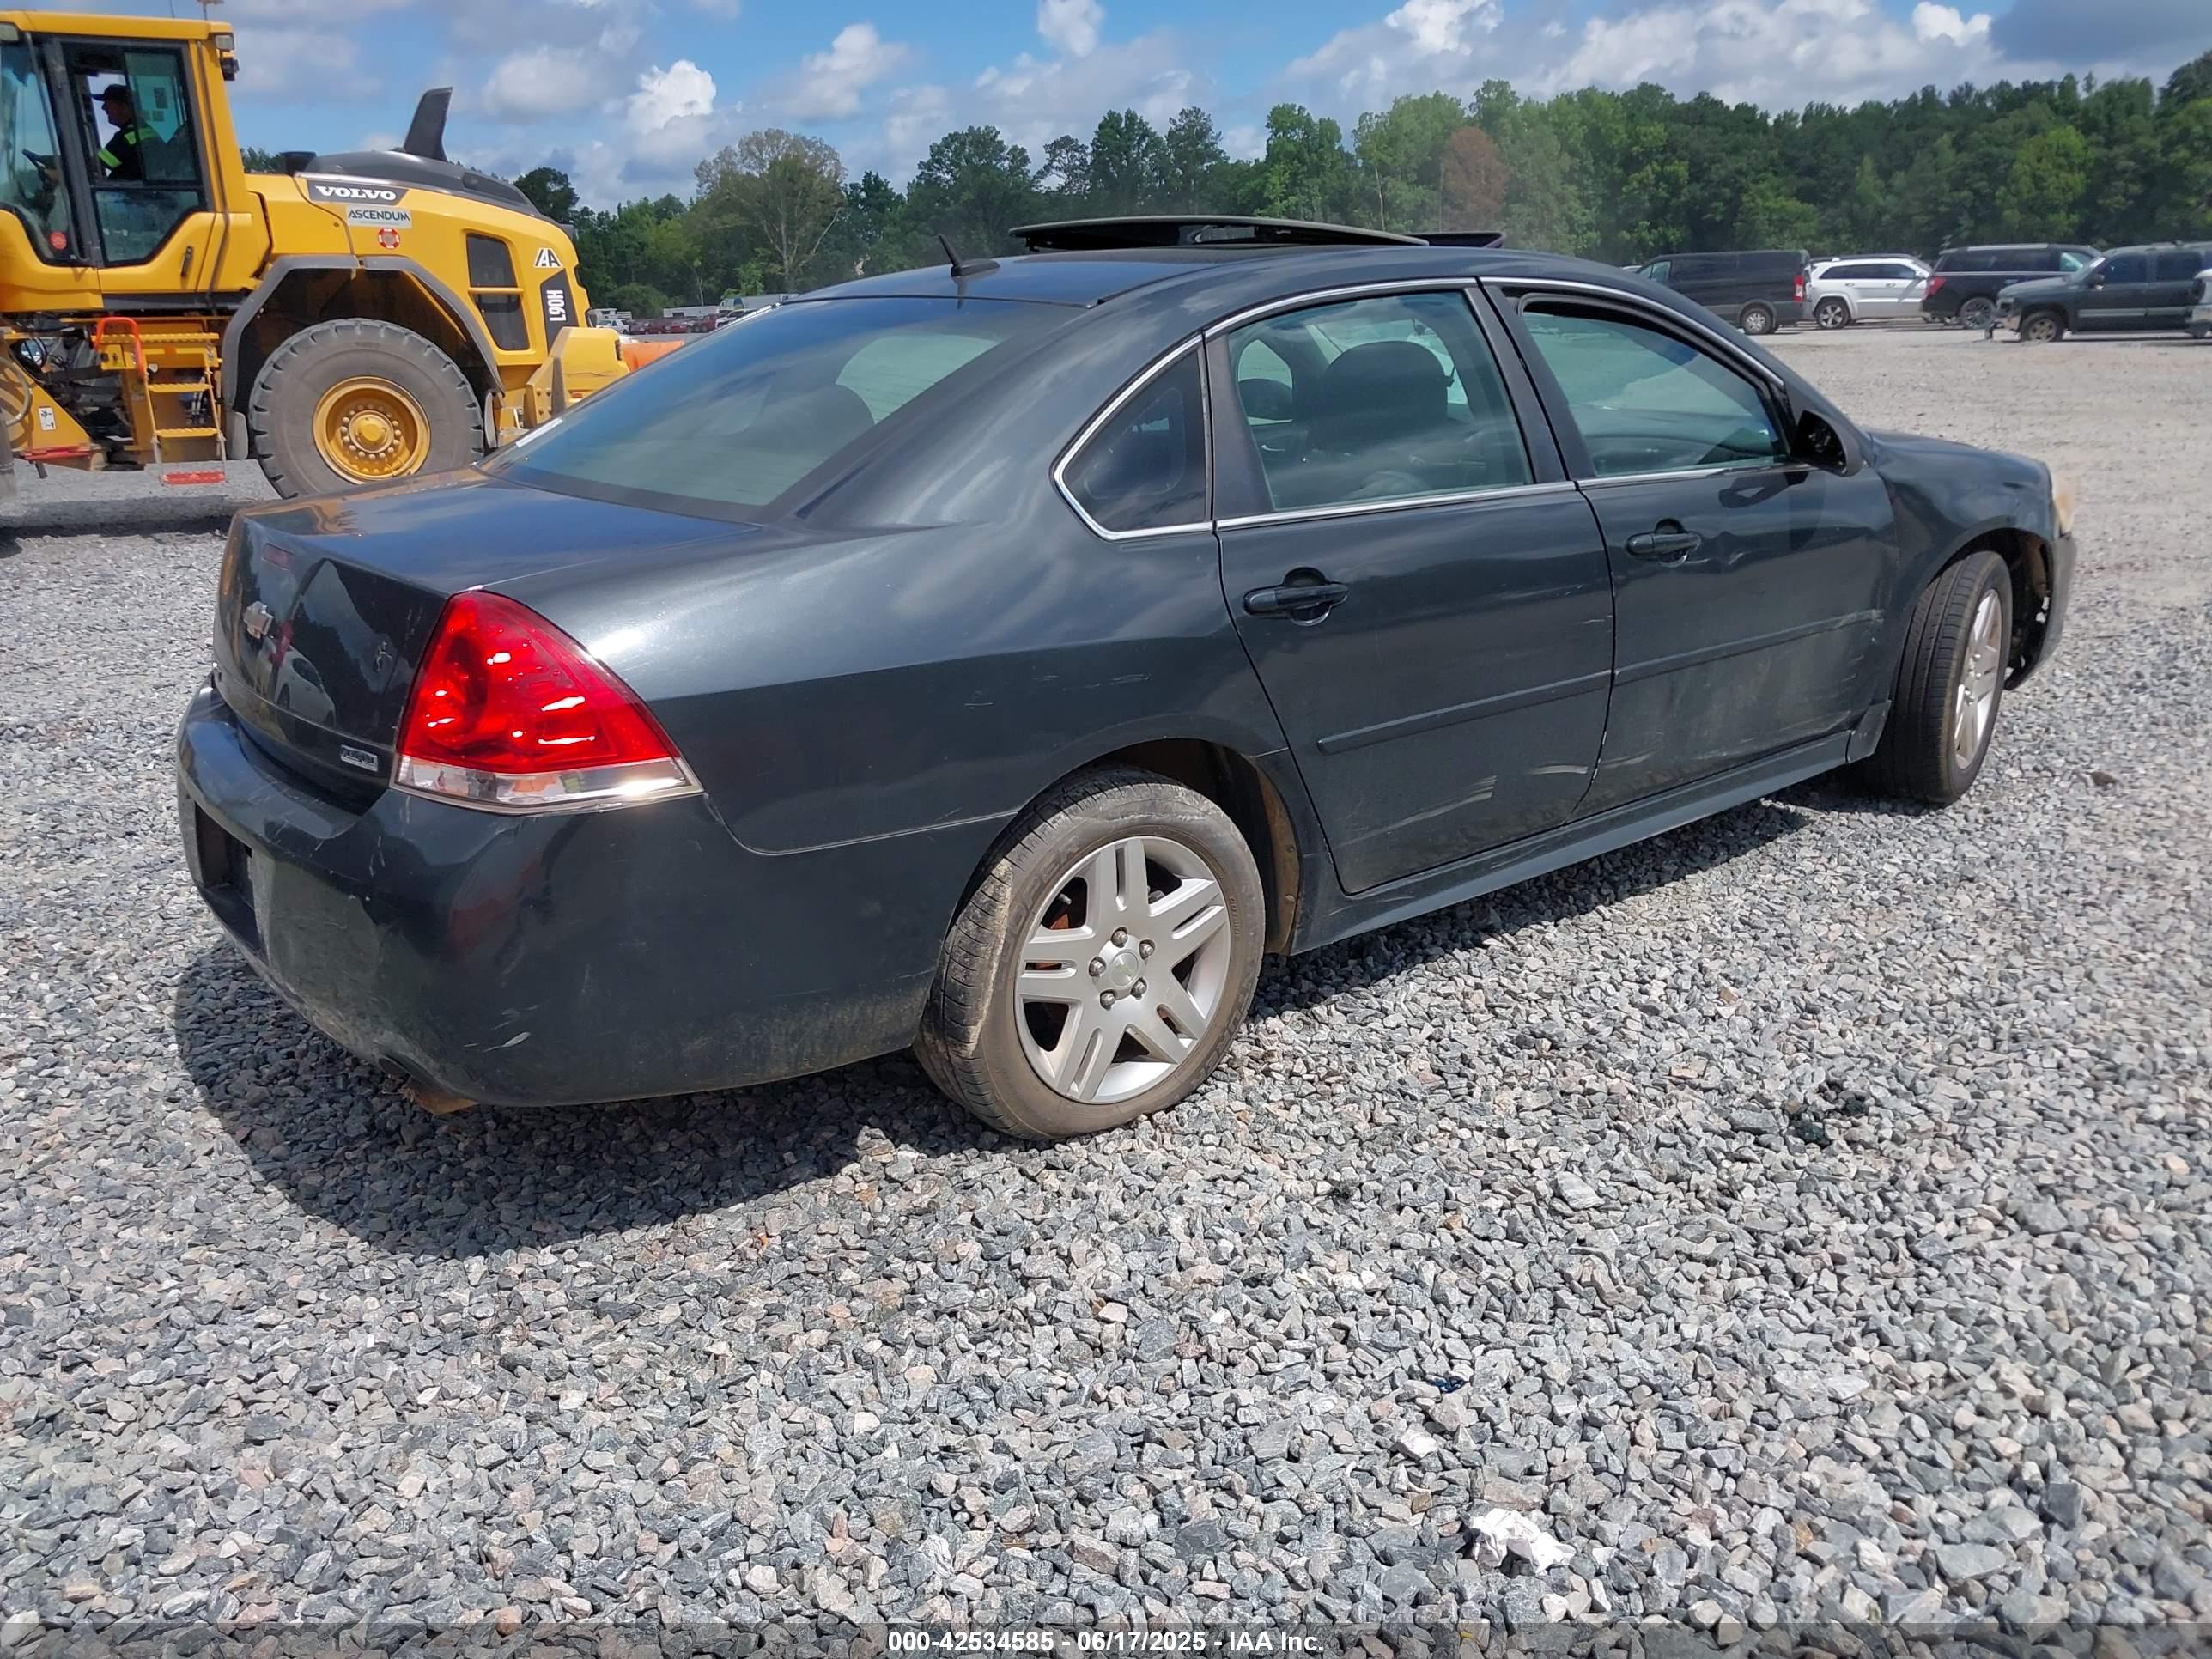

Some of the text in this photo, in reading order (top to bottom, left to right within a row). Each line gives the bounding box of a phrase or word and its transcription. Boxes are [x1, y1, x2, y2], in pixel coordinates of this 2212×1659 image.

[315, 185, 396, 200] VOLVO
[348, 209, 410, 222] ASCENDUM
[547, 289, 567, 321] L90H
